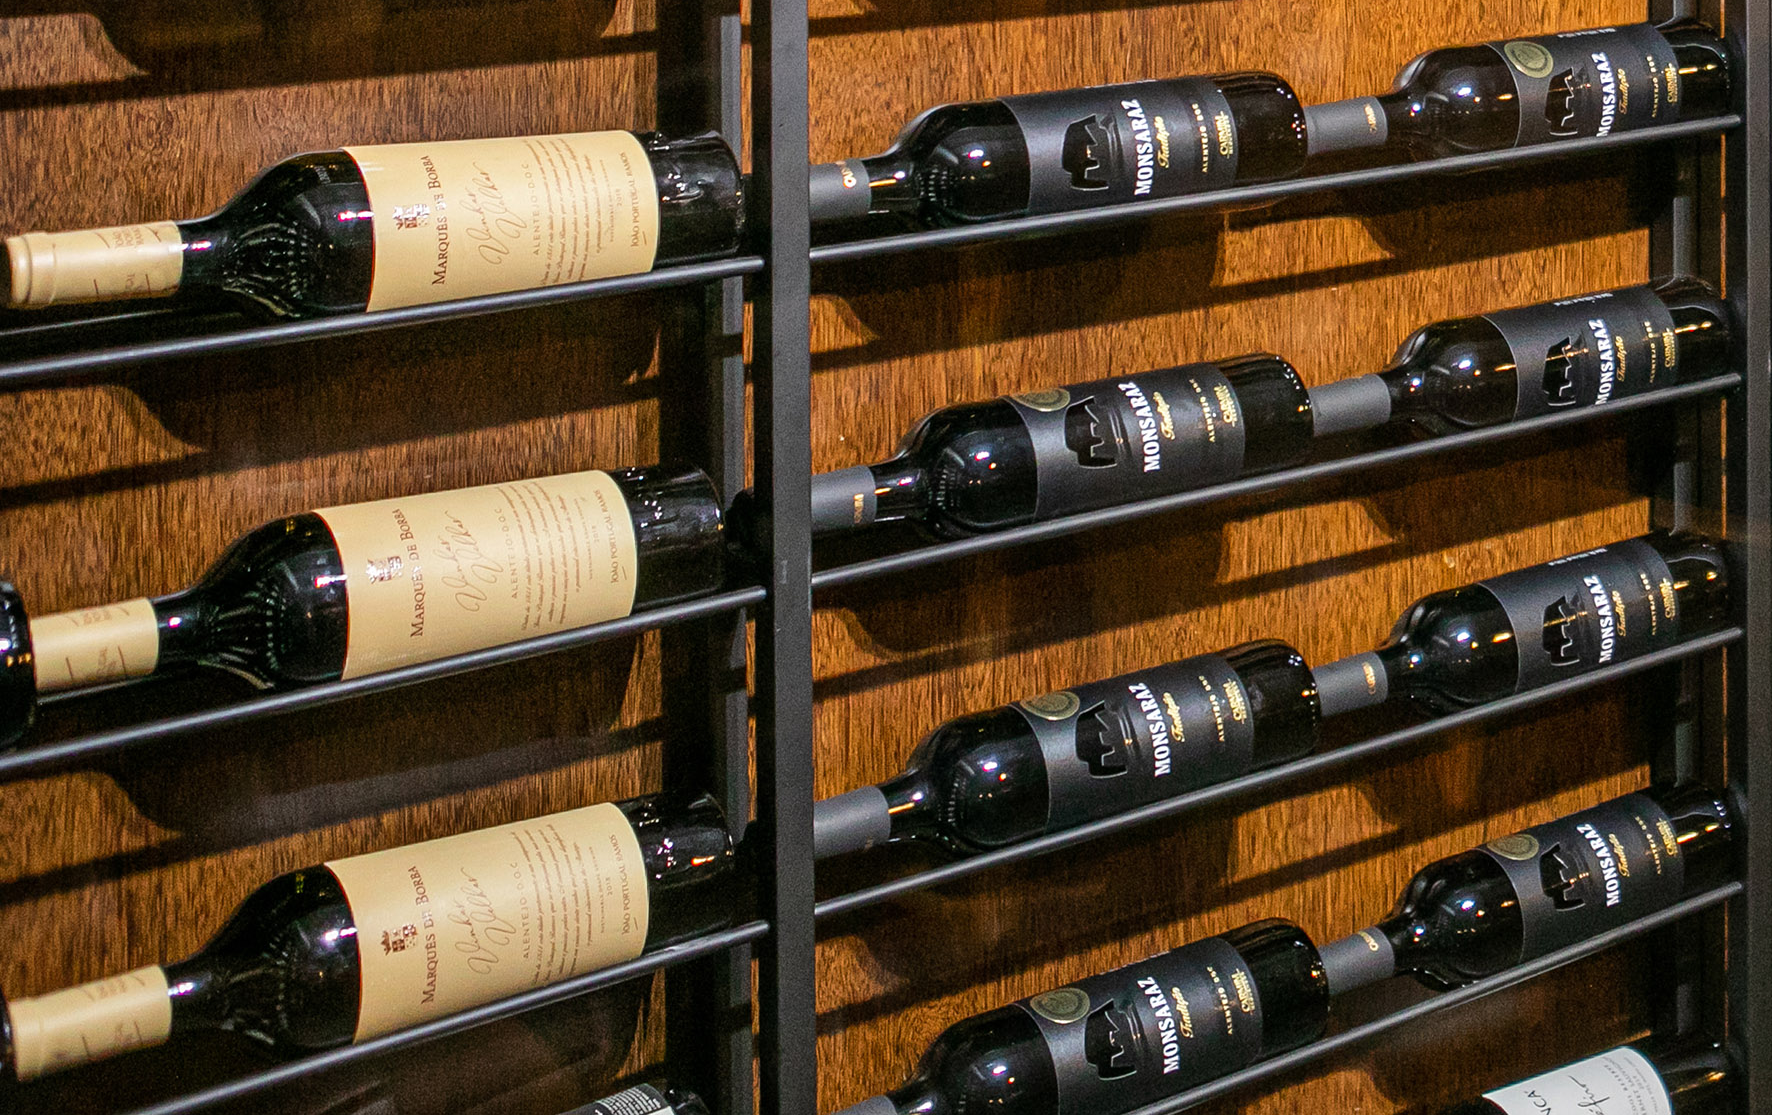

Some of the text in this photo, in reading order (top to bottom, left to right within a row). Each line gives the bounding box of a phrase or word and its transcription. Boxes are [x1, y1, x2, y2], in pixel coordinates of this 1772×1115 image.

[1591, 52, 1615, 137] MONSARAZ
[1617, 68, 1629, 114] Tradição
[1121, 99, 1154, 196] MONSARAZ
[1154, 116, 1170, 169] Tradição
[1192, 103, 1208, 173] ALENTEJO DOC
[420, 155, 442, 191] BORBA
[620, 151, 635, 179] RAMOS
[628, 180, 641, 221] PORTUGAL
[1588, 318, 1615, 404] MONSARAZ
[1615, 335, 1627, 382] Tradição
[1118, 382, 1160, 472] MONSARAZ
[1200, 396, 1215, 443] ALENTEJO
[393, 508, 415, 542] BORBA
[593, 489, 610, 516] RAMOS
[407, 544, 419, 560] DE
[605, 517, 619, 559] PORTUGAL
[1587, 574, 1615, 664] MONSARAZ
[1128, 683, 1171, 777] MONSARAZ
[1163, 692, 1185, 742] Tradição
[1209, 694, 1225, 742] ALENTEJO
[608, 834, 624, 862] RAMOS
[1576, 823, 1621, 907] MONSARAZ
[1608, 833, 1630, 877] Tradição
[408, 866, 430, 906] BORBA
[614, 862, 631, 910] PORTUGAL
[421, 933, 439, 1005] MARQUÊS
[1137, 976, 1180, 1074] MONSARAZ
[1171, 986, 1193, 1038] Tradição
[1217, 986, 1233, 1035] ALENTEJO
